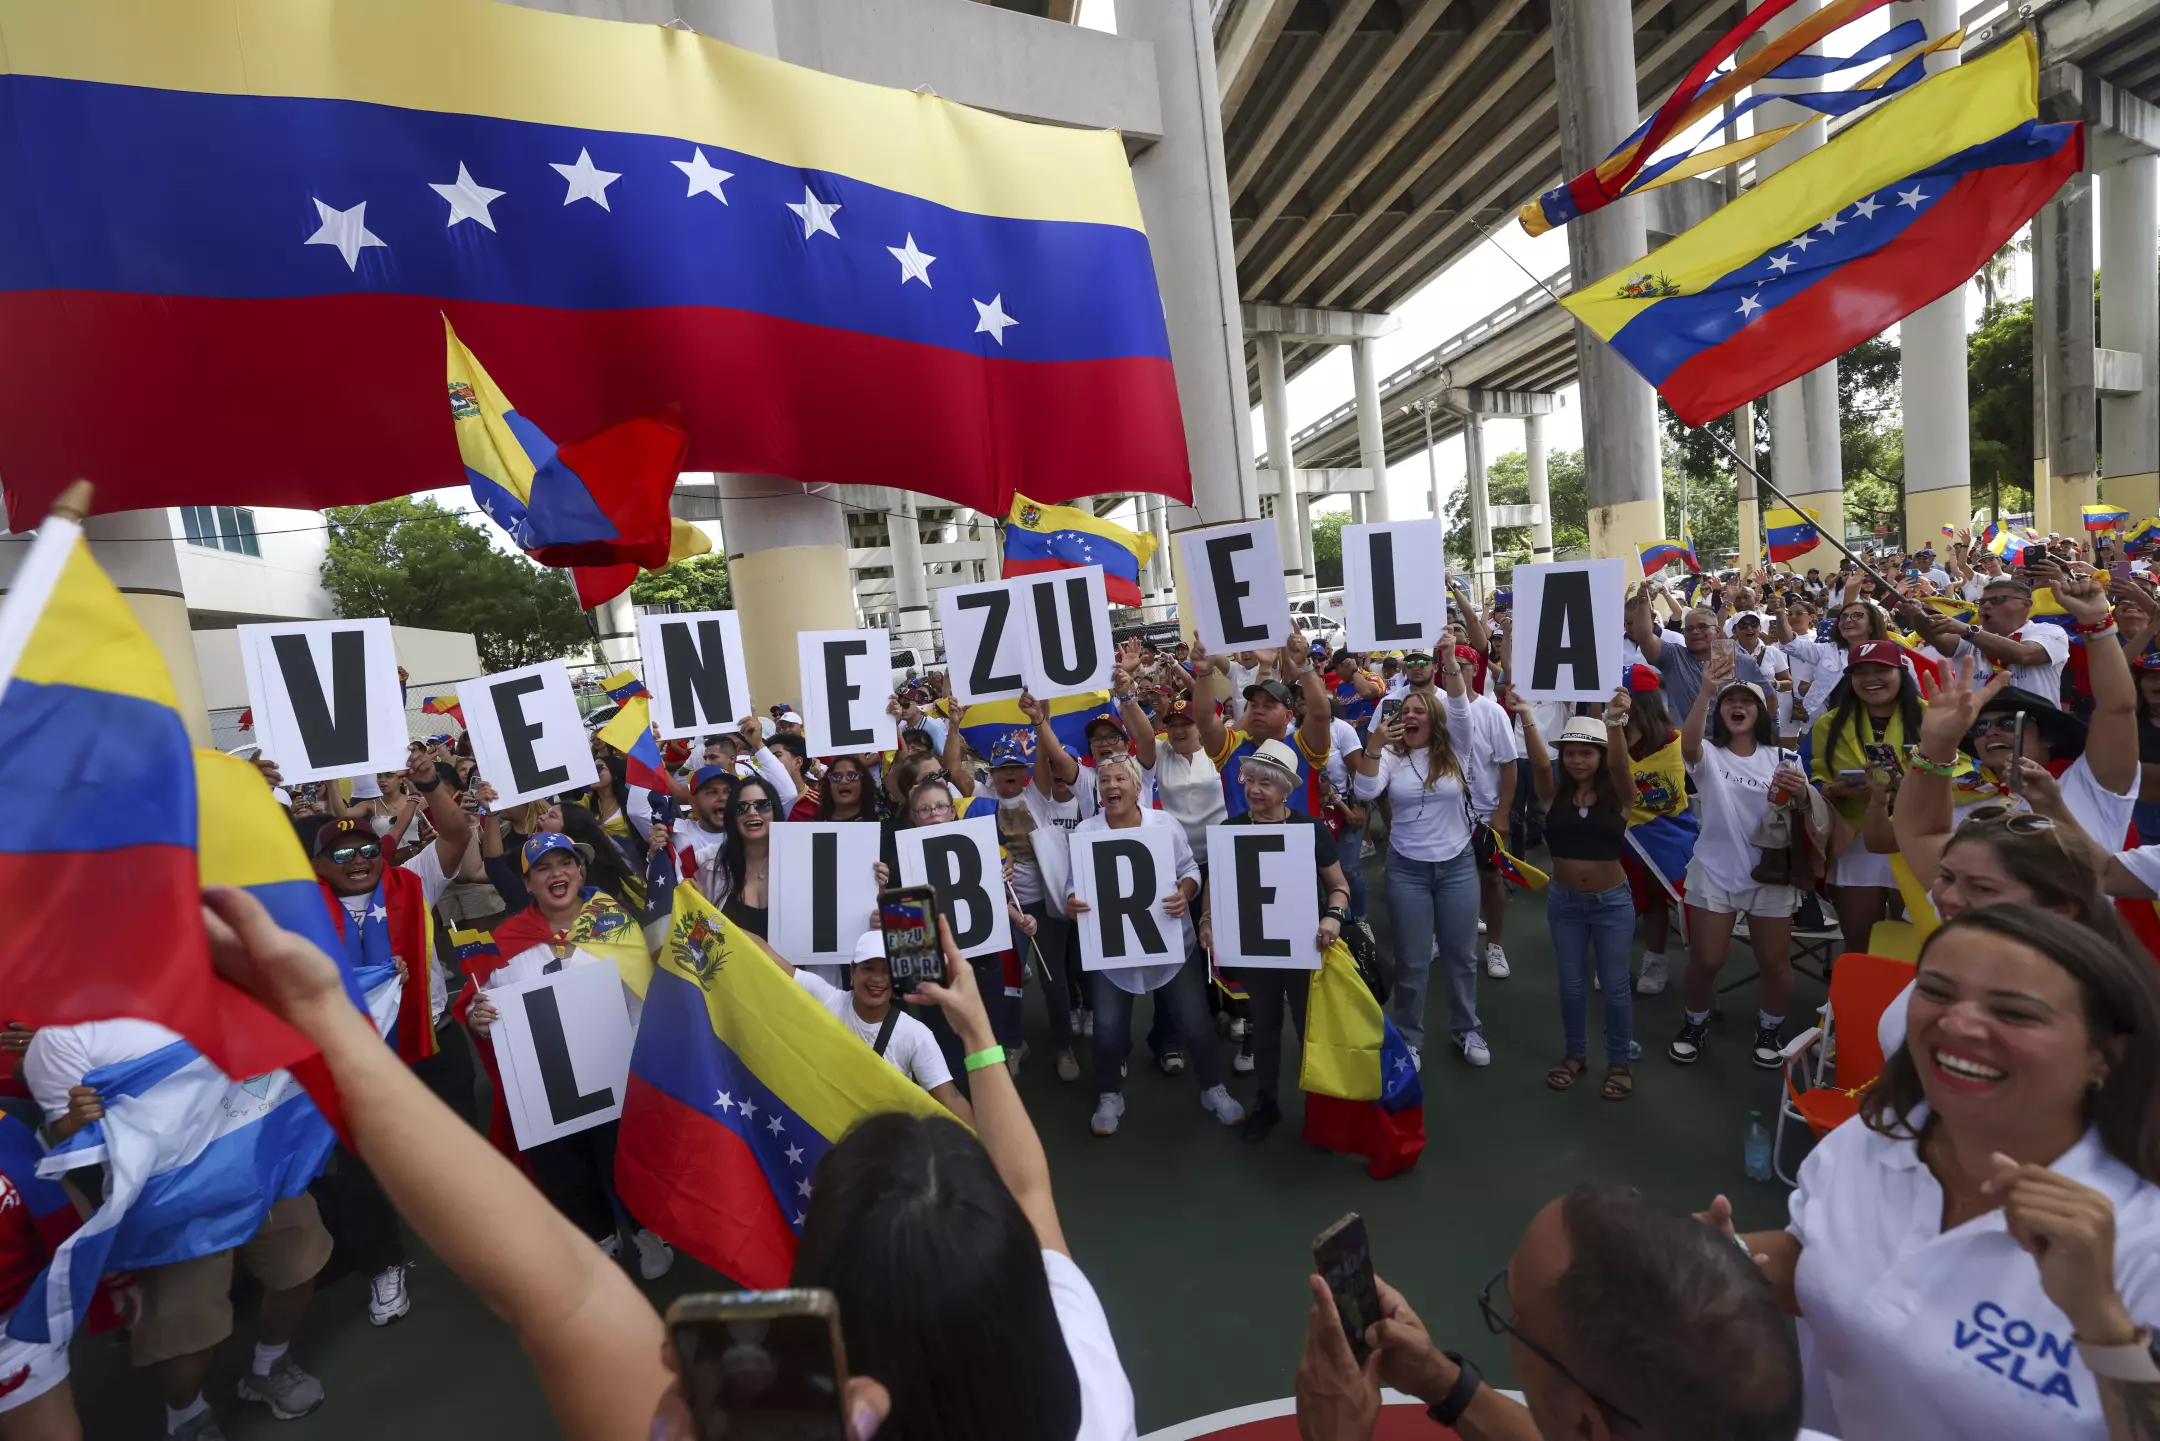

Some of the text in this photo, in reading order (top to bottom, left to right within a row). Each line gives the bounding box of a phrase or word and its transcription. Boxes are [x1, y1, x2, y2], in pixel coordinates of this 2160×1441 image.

[957, 589, 1022, 695] Z
[1032, 577, 1098, 685] U
[1206, 533, 1269, 644] E
[1369, 532, 1422, 641] L
[1532, 571, 1602, 690] A
[271, 631, 368, 769] V
[661, 620, 733, 728] N
[824, 640, 874, 747] E
[490, 675, 569, 794] E
[1719, 768, 1771, 788] IMÓN
[813, 833, 837, 953] I
[922, 834, 994, 949] B
[1092, 839, 1168, 958] R
[1234, 835, 1291, 957] E
[522, 986, 615, 1125] L
[1954, 1319, 2079, 1408] VZLA
[1973, 1301, 2072, 1368] CON
